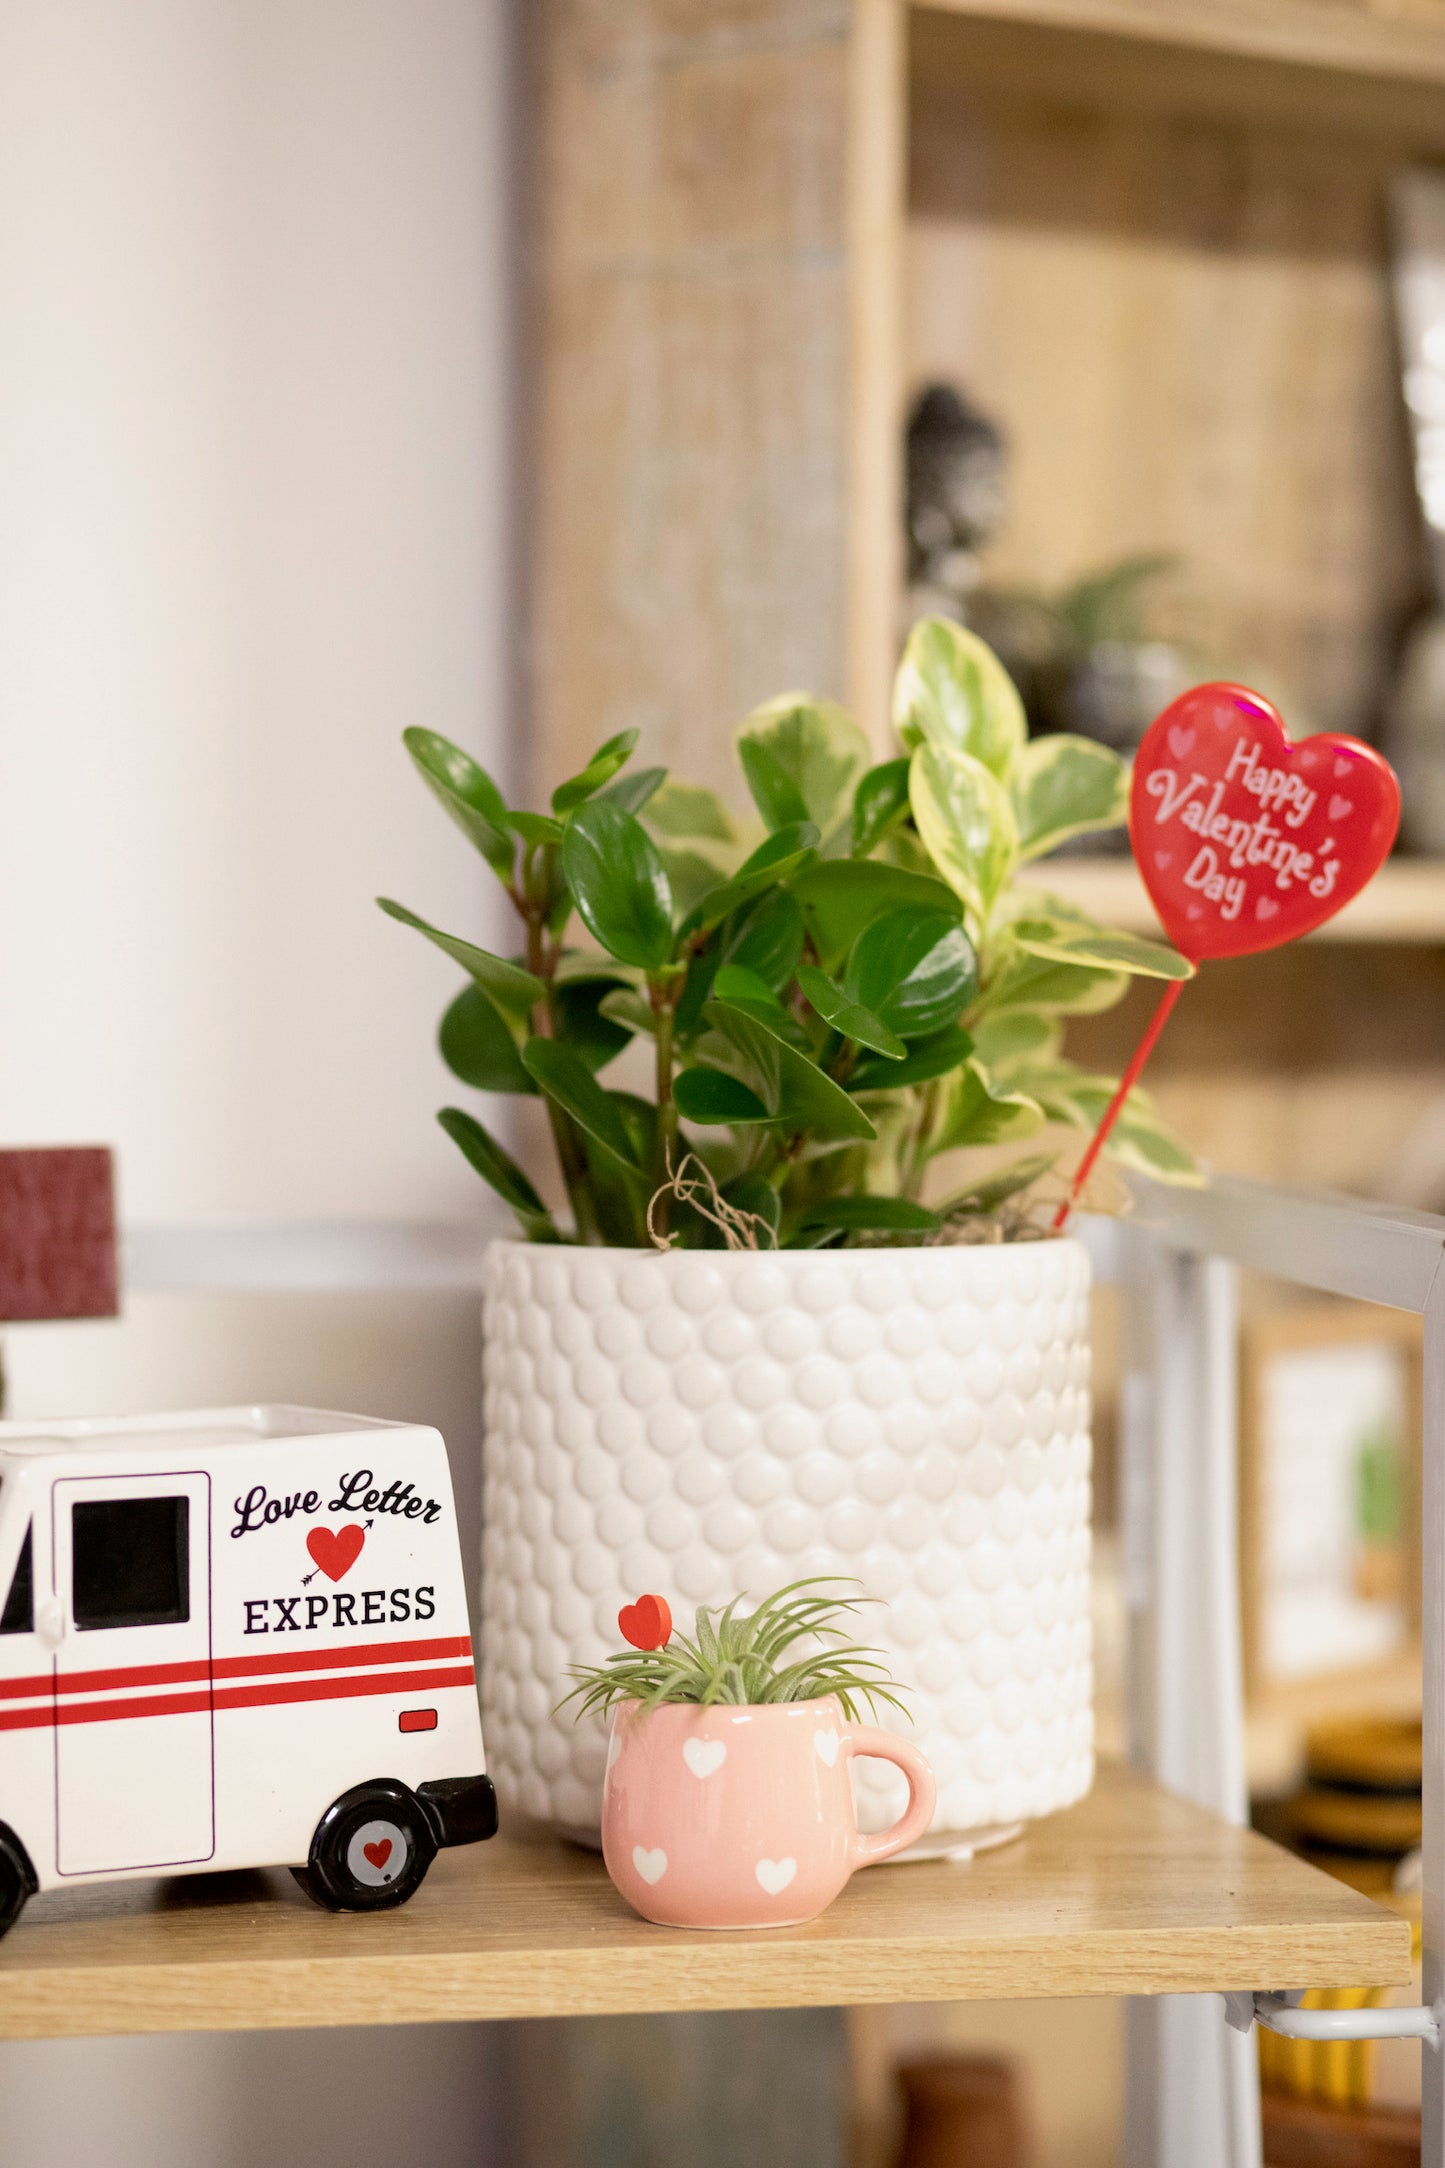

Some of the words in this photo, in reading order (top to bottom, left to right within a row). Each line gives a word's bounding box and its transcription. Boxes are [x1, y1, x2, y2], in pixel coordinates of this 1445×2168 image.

[1224, 737, 1317, 828] Happy
[1145, 768, 1341, 898] Valentine's
[1183, 845, 1246, 921] Day
[230, 1485, 323, 1539] Love
[328, 1469, 442, 1524] Letter
[243, 1586, 436, 1635] EXPRESS
